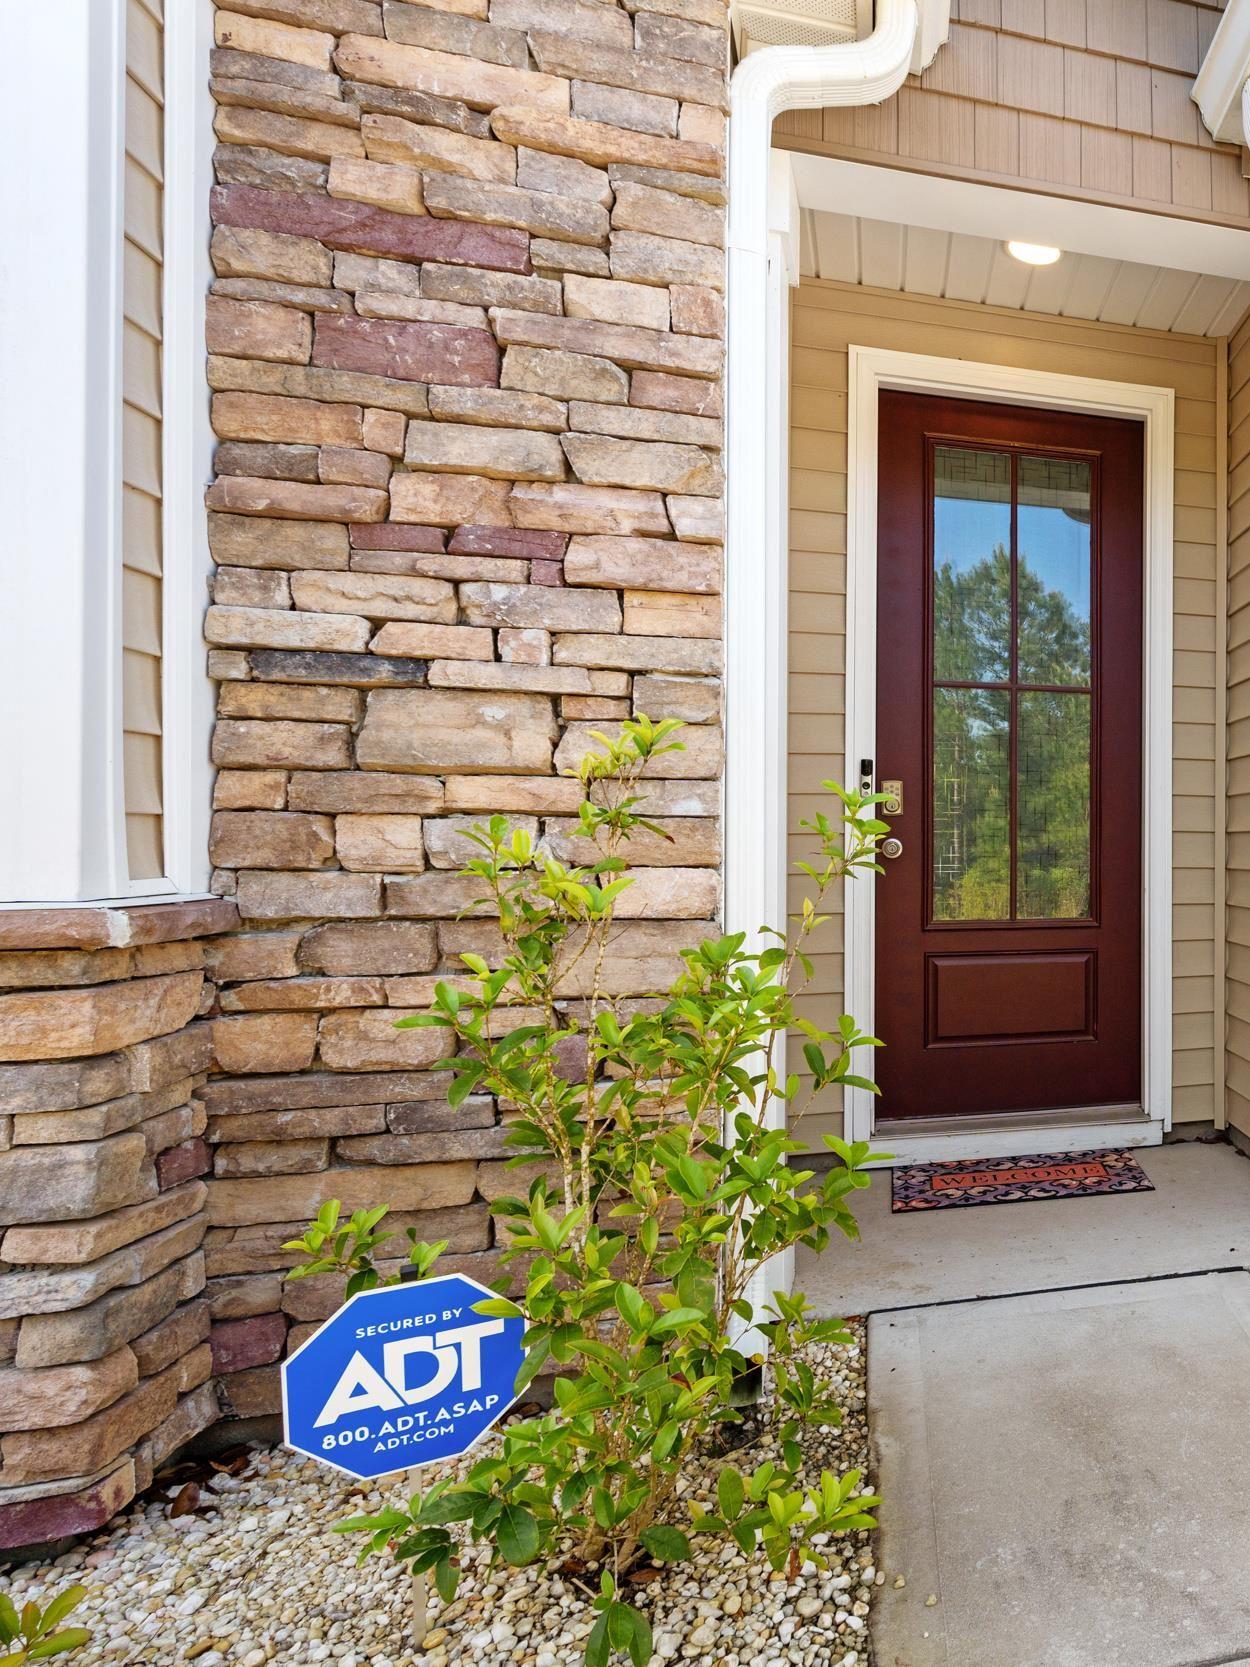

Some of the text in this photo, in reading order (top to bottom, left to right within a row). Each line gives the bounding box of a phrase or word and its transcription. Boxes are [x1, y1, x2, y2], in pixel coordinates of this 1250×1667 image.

[940, 1166, 1101, 1186] WELCOME
[355, 1307, 463, 1339] SECURED BY
[312, 1318, 505, 1429] ADT
[321, 1394, 499, 1450] 800.ADT.ASAP
[373, 1424, 455, 1453] ADT.COM
